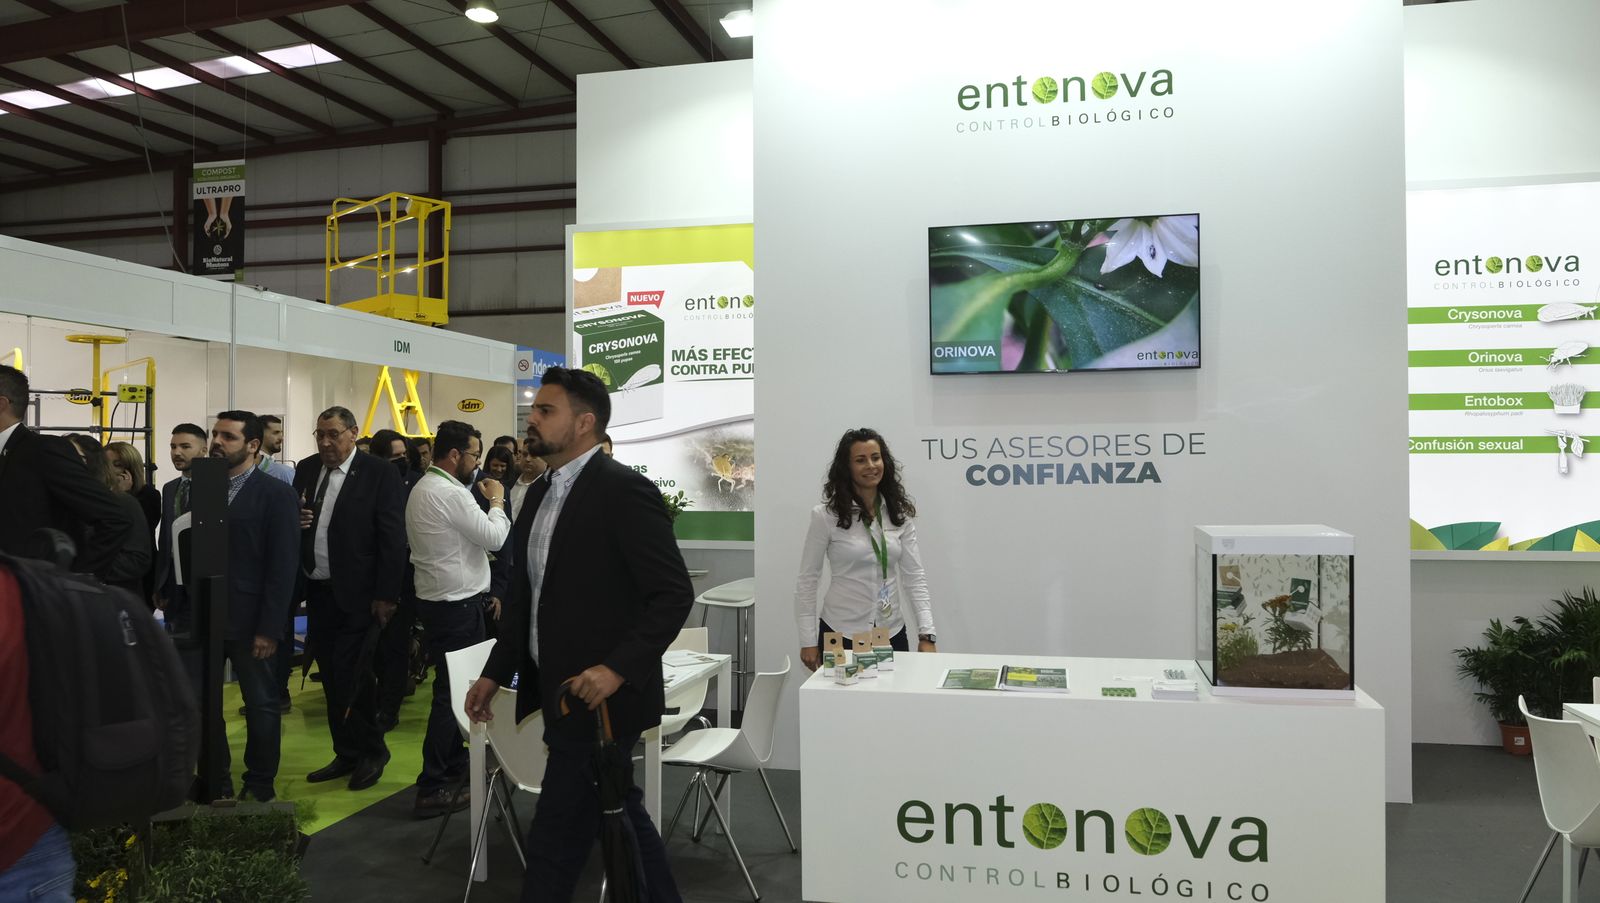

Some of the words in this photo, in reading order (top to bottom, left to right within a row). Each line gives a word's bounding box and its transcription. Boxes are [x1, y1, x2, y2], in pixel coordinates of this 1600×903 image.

[957, 68, 1174, 112] entonova
[201, 167, 236, 176] COMPOST
[196, 184, 241, 195] ULTRAPRO
[1434, 254, 1580, 277] entonova
[630, 294, 660, 303] NUEVO
[575, 312, 647, 329] CRYSONOVA
[1447, 308, 1523, 322] Crysonova
[393, 340, 411, 354] IDM
[588, 332, 659, 355] CRYSONOVA
[671, 345, 708, 362] MÁS
[713, 347, 754, 360] EFEC
[934, 345, 996, 358] ORINOVA
[1136, 350, 1199, 361] entonova
[1468, 351, 1523, 363] Orinova
[670, 363, 727, 376] CONTRA
[461, 400, 480, 410] idm
[1464, 395, 1524, 407] Entobox
[920, 437, 978, 460] TUS
[986, 433, 1151, 459] ASESORES
[1162, 432, 1207, 456] DE
[1408, 438, 1474, 451] Confusión
[1478, 438, 1524, 451] sexual
[965, 461, 1162, 487] CONFIANZA
[896, 794, 1270, 864] entonova
